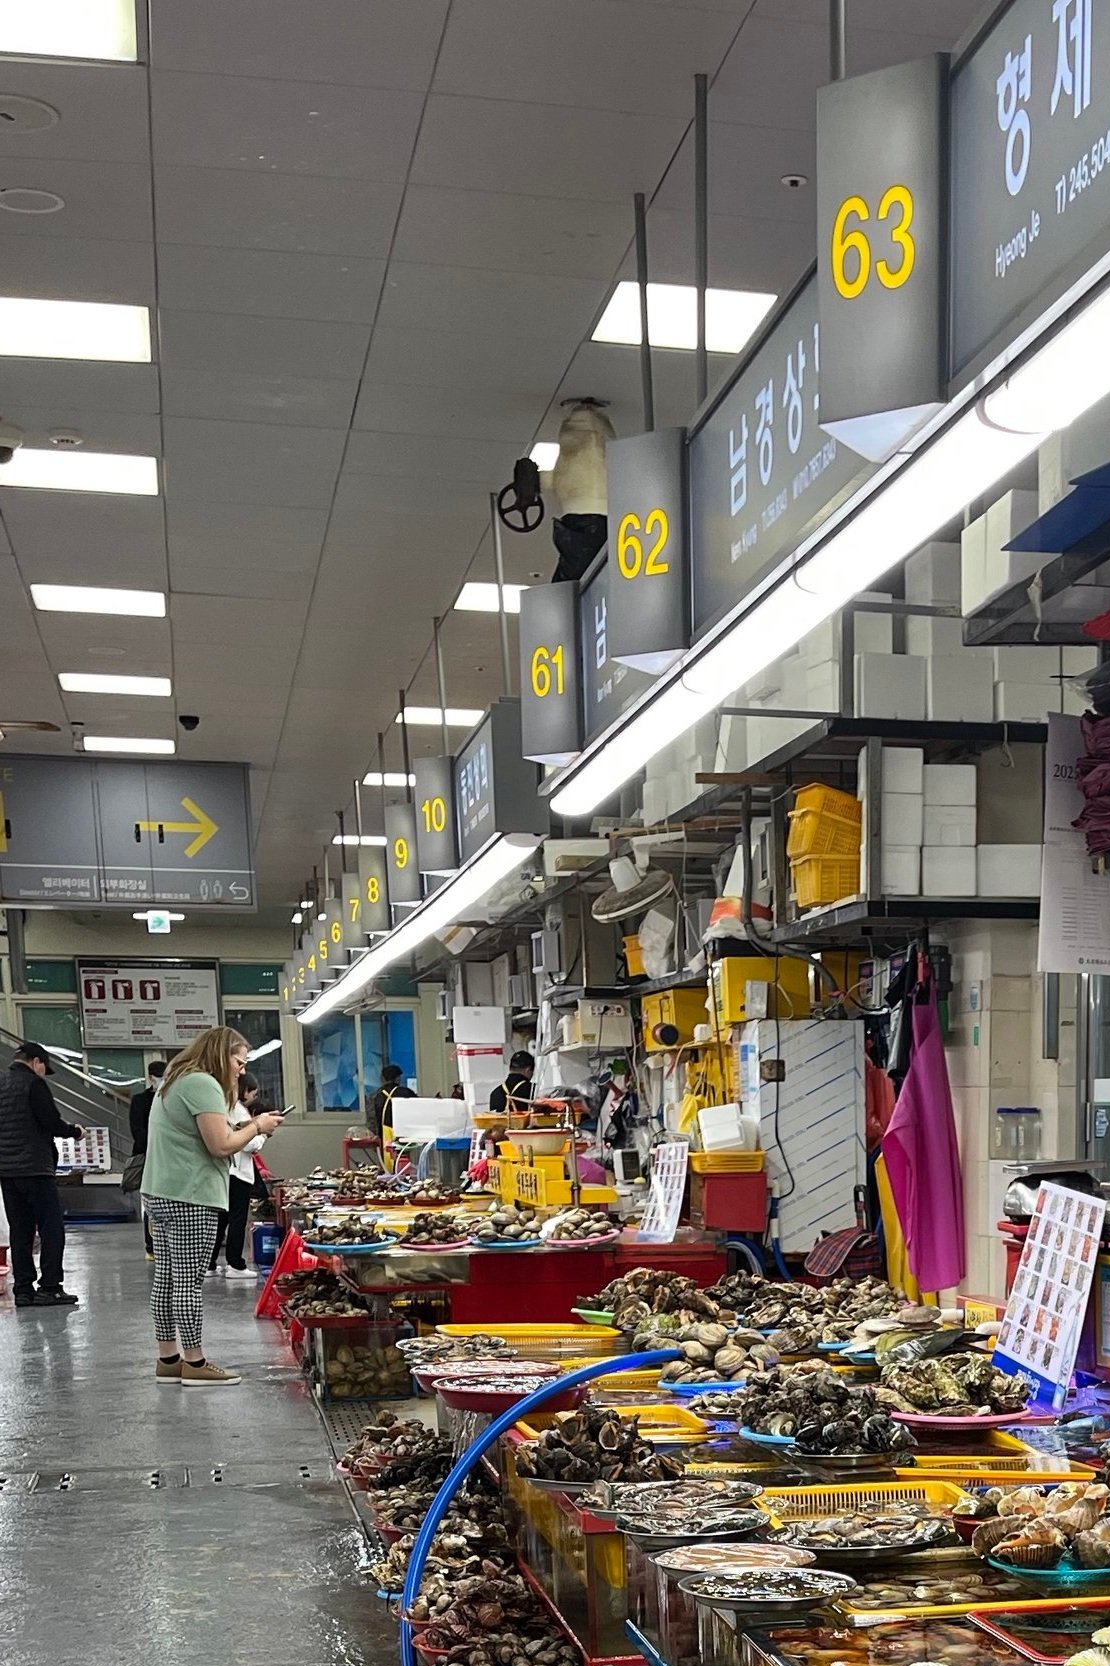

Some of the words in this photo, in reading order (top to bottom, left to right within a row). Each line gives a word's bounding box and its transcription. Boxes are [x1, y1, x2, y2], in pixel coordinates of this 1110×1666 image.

[995, 224, 1028, 278] Hyeong
[1028, 209, 1041, 243] Je
[1055, 174, 1067, 214] T)
[831, 185, 915, 299] 63
[729, 323, 819, 517] 남경상
[616, 508, 670, 580] 62
[530, 645, 565, 697] 61
[421, 797, 446, 832] 10
[394, 838, 408, 868] 9
[42, 877, 90, 889] 엘리베이터
[367, 877, 379, 903] 8
[349, 899, 360, 922] 7
[331, 922, 342, 943] 6
[307, 954, 316, 972] 4
[319, 940, 328, 959] 5
